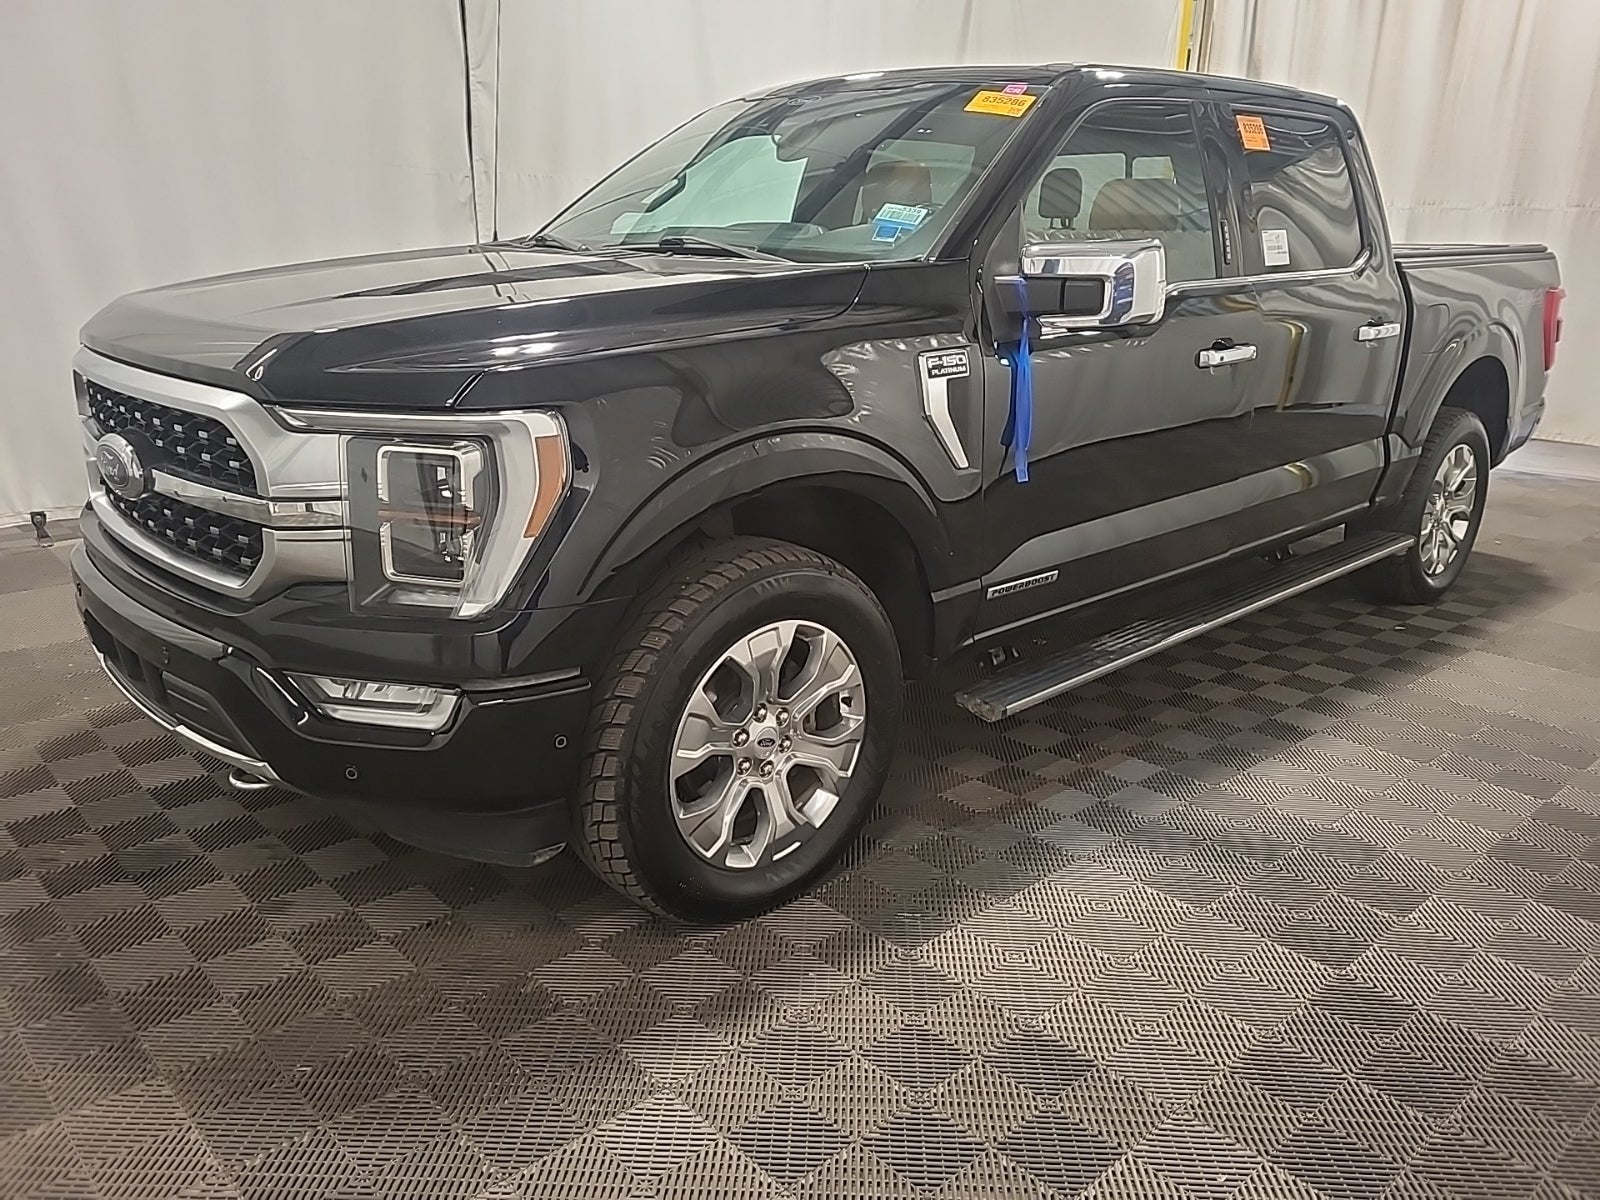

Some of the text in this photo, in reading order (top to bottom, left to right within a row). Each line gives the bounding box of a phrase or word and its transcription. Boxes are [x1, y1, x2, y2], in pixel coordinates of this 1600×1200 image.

[927, 354, 967, 368] F-150
[931, 365, 966, 375] PLATINUM
[991, 573, 1056, 597] POWERBOOST
